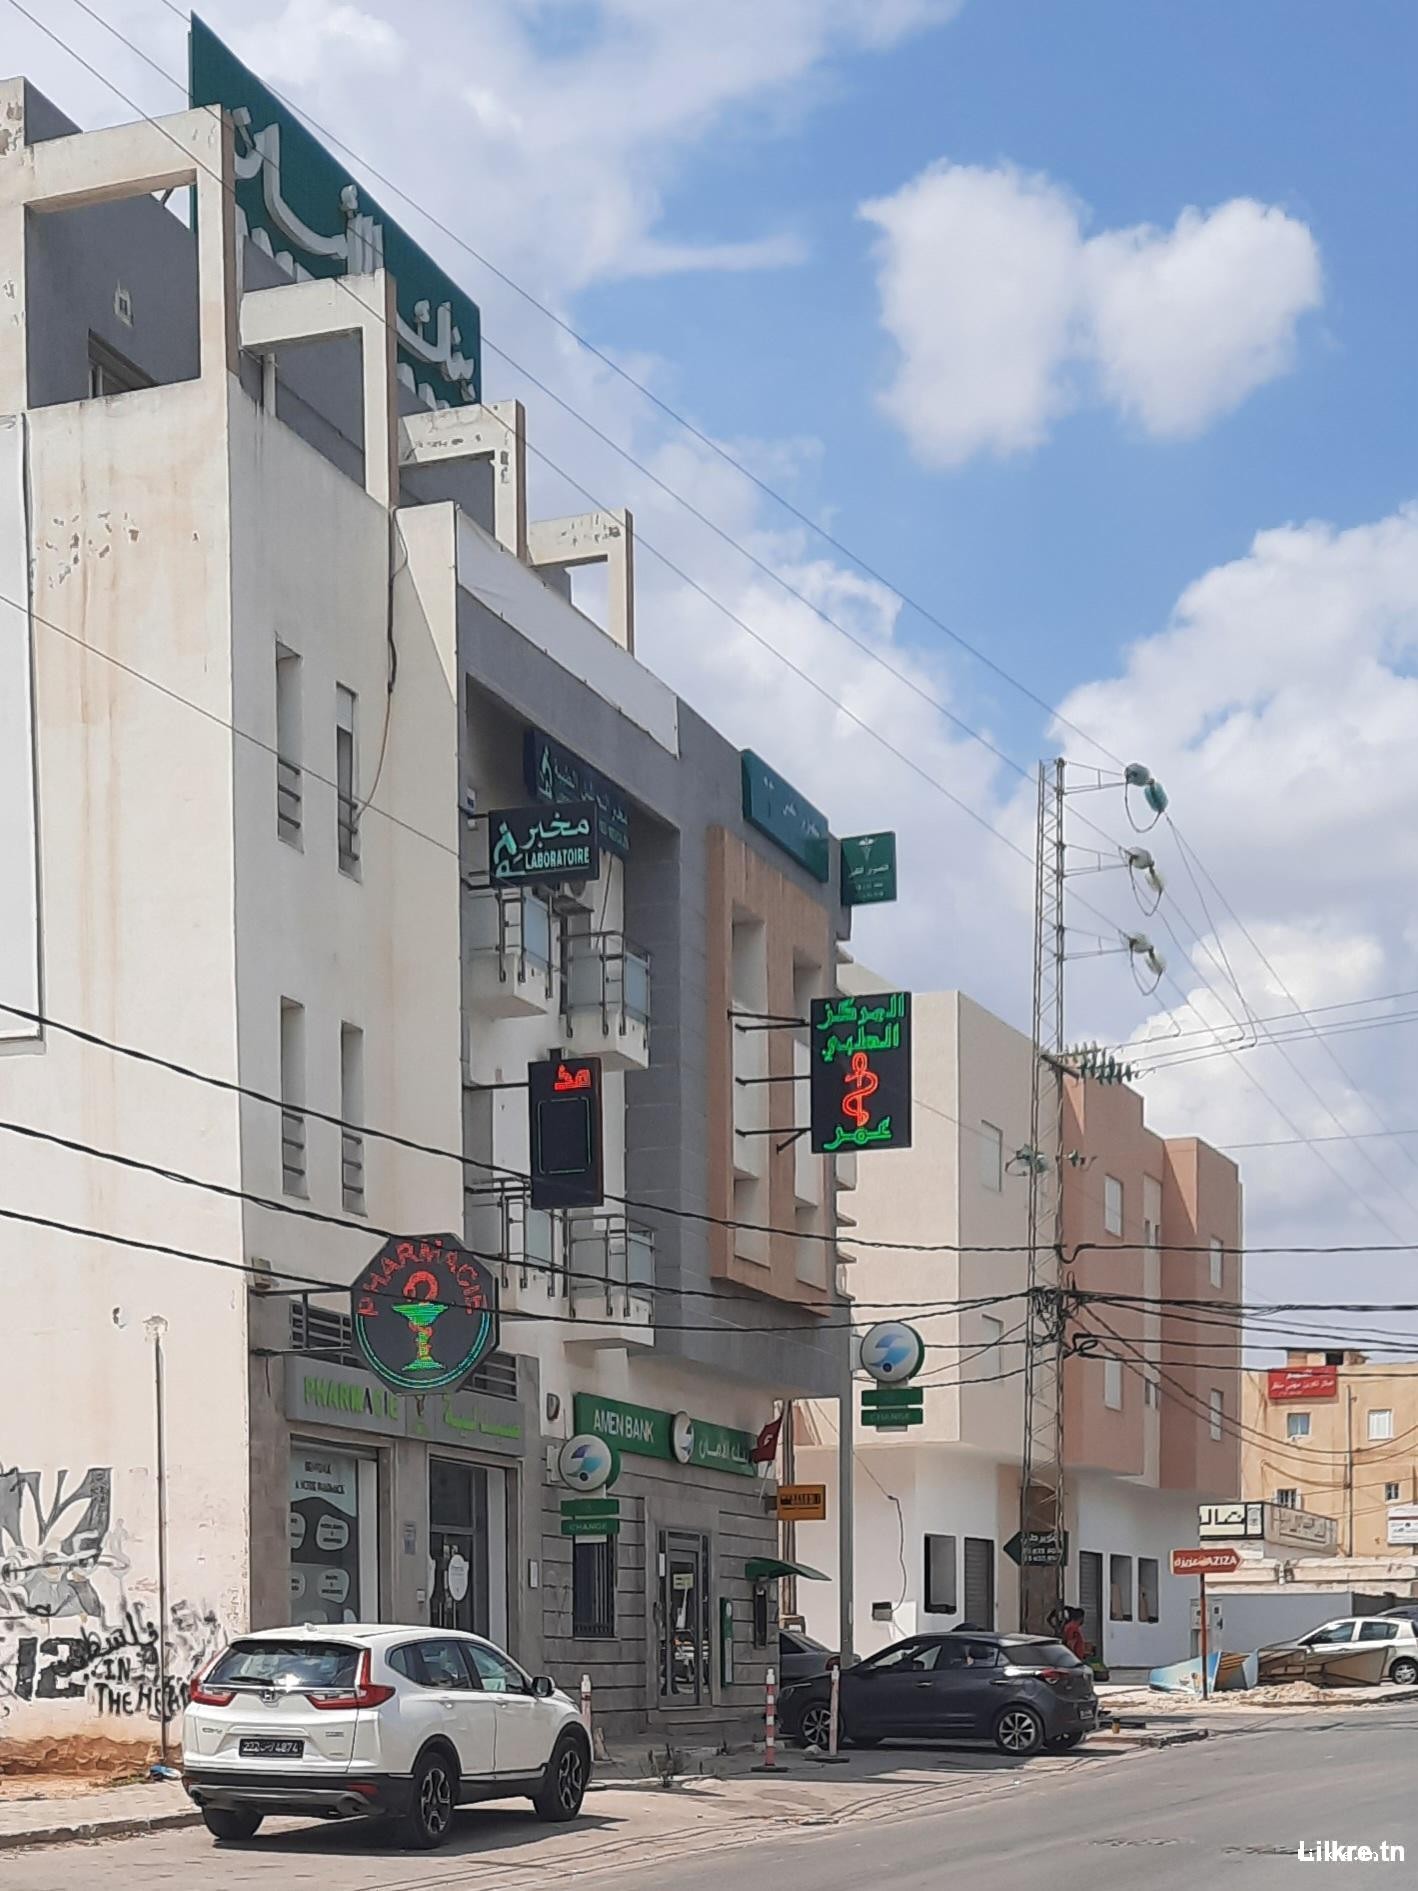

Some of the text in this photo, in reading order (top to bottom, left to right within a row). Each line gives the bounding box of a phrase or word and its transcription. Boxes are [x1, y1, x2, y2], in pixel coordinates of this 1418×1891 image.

[520, 811, 590, 850] مخبر
[525, 847, 590, 869] LABORATOIRE
[816, 992, 905, 1030] المركز
[821, 1023, 899, 1062] الطبي
[823, 1116, 892, 1151] عمر
[357, 1238, 487, 1317] PHARMACIE
[593, 1409, 655, 1443] AMEN BANK
[103, 1656, 131, 1684] IN
[94, 1683, 134, 1717] THE
